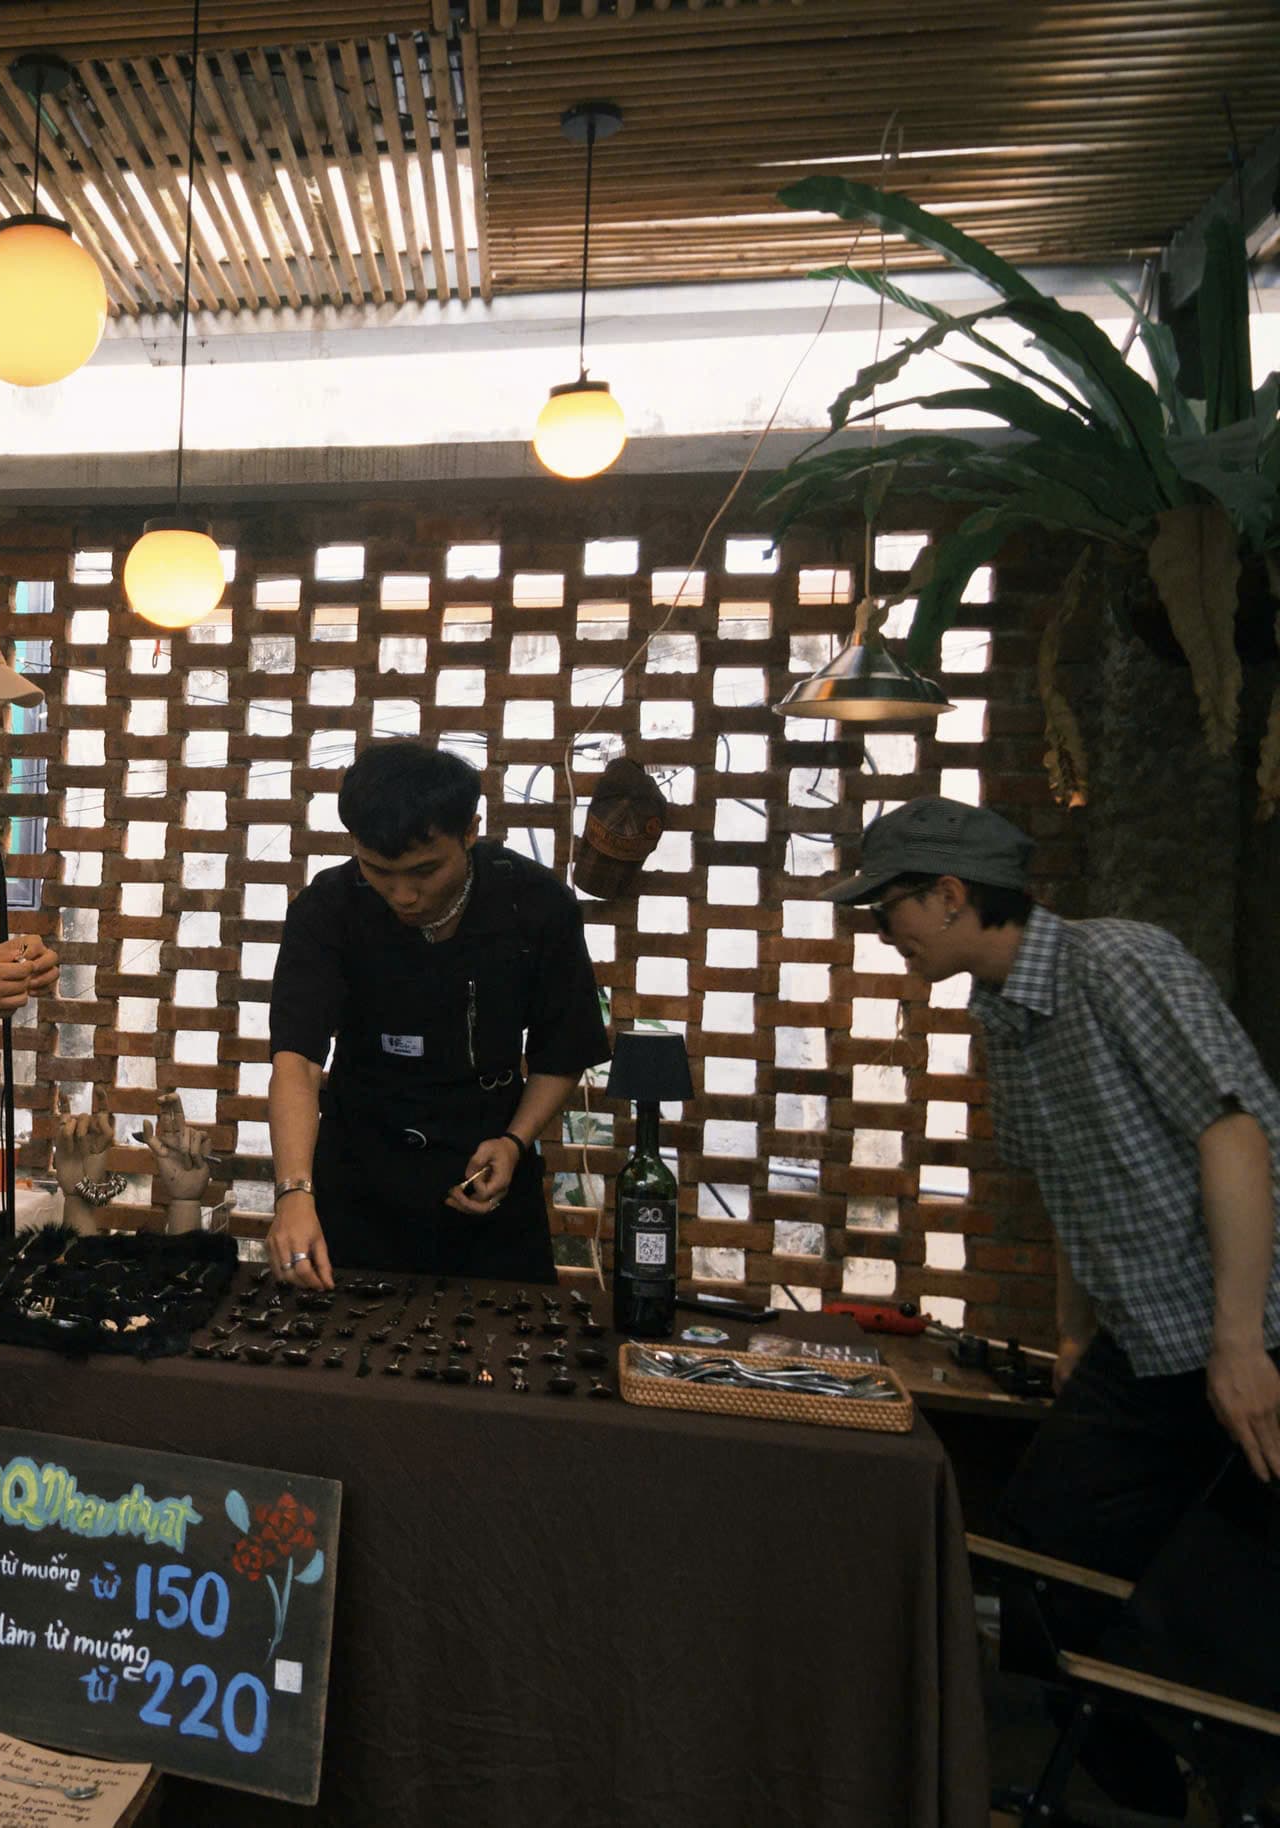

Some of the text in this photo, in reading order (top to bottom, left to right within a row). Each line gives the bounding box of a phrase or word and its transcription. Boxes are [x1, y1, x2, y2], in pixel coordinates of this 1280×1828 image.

[0, 1550, 19, 1576] từ
[22, 1552, 81, 1591] muỗng
[90, 1561, 122, 1600] từ
[135, 1563, 230, 1639] 150
[44, 1619, 70, 1650] từ
[74, 1627, 150, 1681] muỗng
[79, 1660, 269, 1753] từ 220
